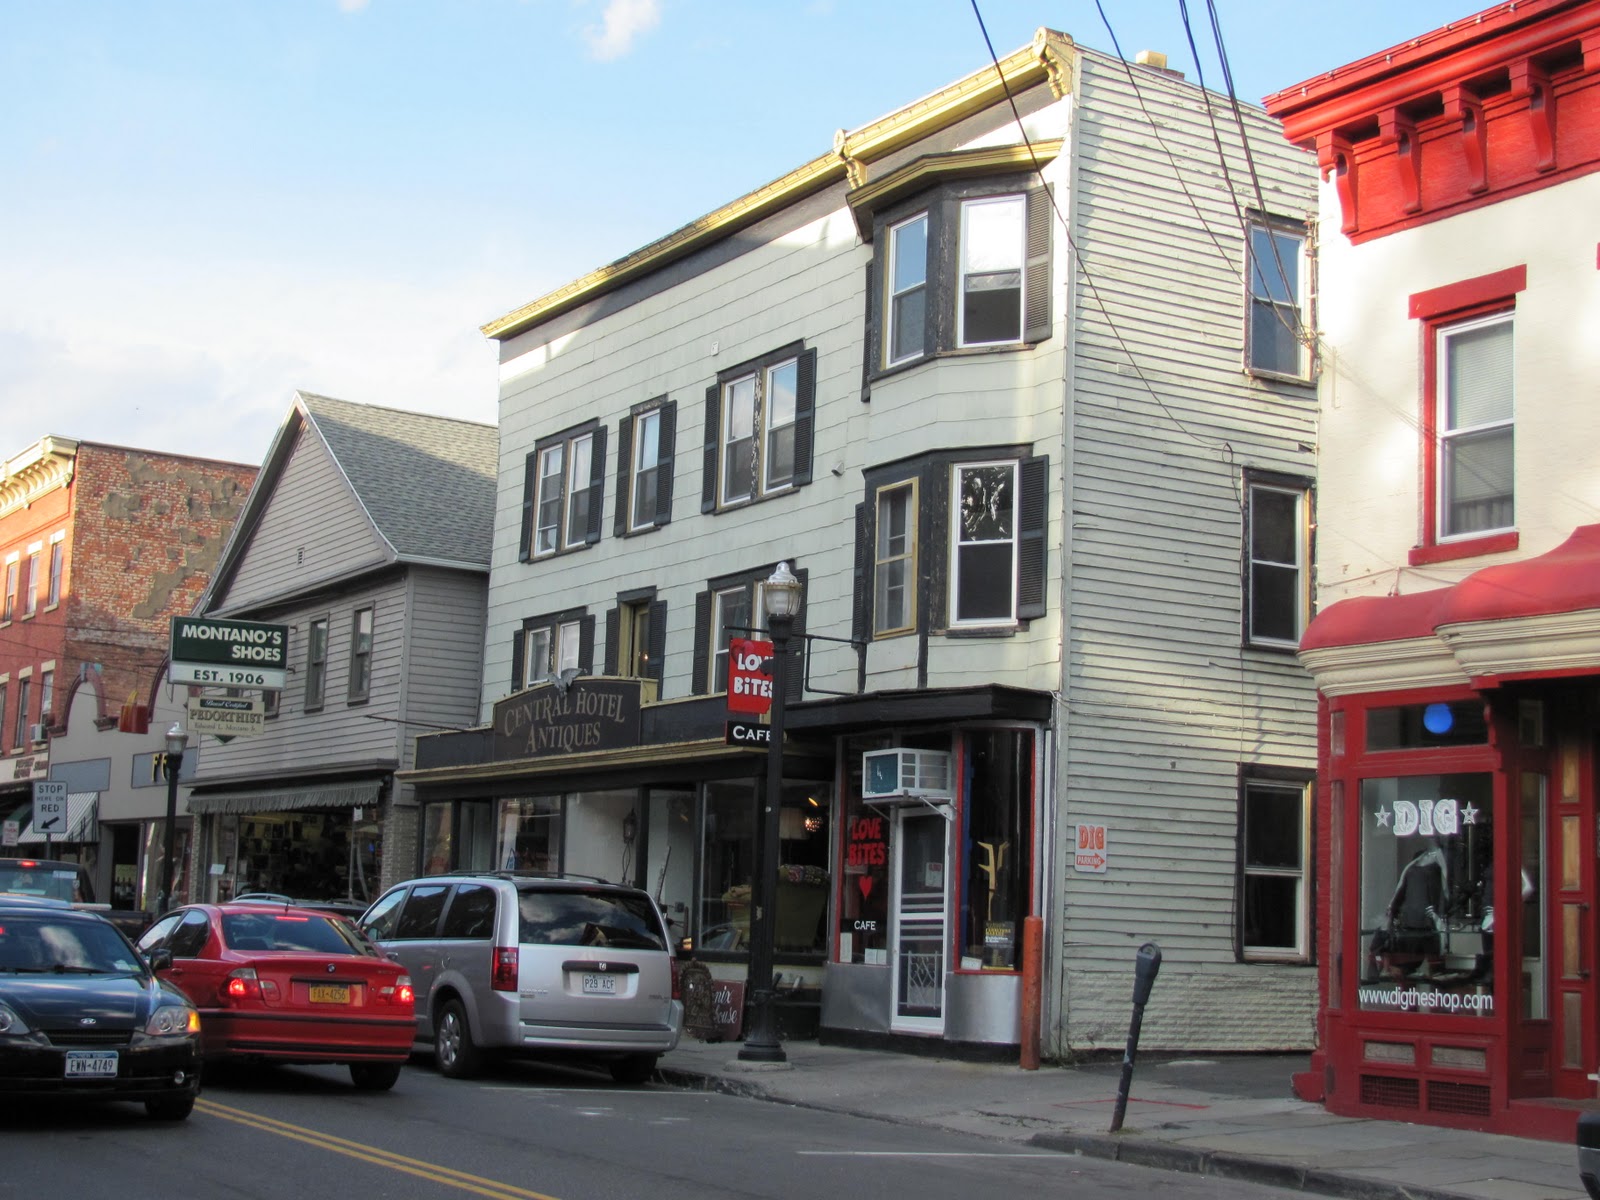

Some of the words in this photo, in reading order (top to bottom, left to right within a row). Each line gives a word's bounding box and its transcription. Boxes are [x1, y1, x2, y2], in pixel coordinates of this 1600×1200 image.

[182, 624, 282, 645] MONTANO'S
[231, 645, 281, 661] SHOES
[737, 652, 774, 671] LOV
[193, 669, 224, 682] EST.
[229, 672, 265, 685] 1906
[189, 708, 263, 724] PEDORTHIST
[504, 694, 572, 737] CENTRAL
[575, 691, 625, 723] HOTEL
[524, 721, 601, 753] ANTIQUES
[38, 784, 63, 794] STOP
[41, 803, 60, 813] RED
[1393, 798, 1458, 836] DIG
[851, 817, 882, 840] LOVE
[1078, 824, 1105, 850] DIG
[1077, 855, 1101, 865] PARKING
[853, 920, 877, 931] CAFE
[584, 978, 598, 989] P29
[602, 979, 615, 990] ACF
[1358, 987, 1493, 1011] www.digtheshop.com
